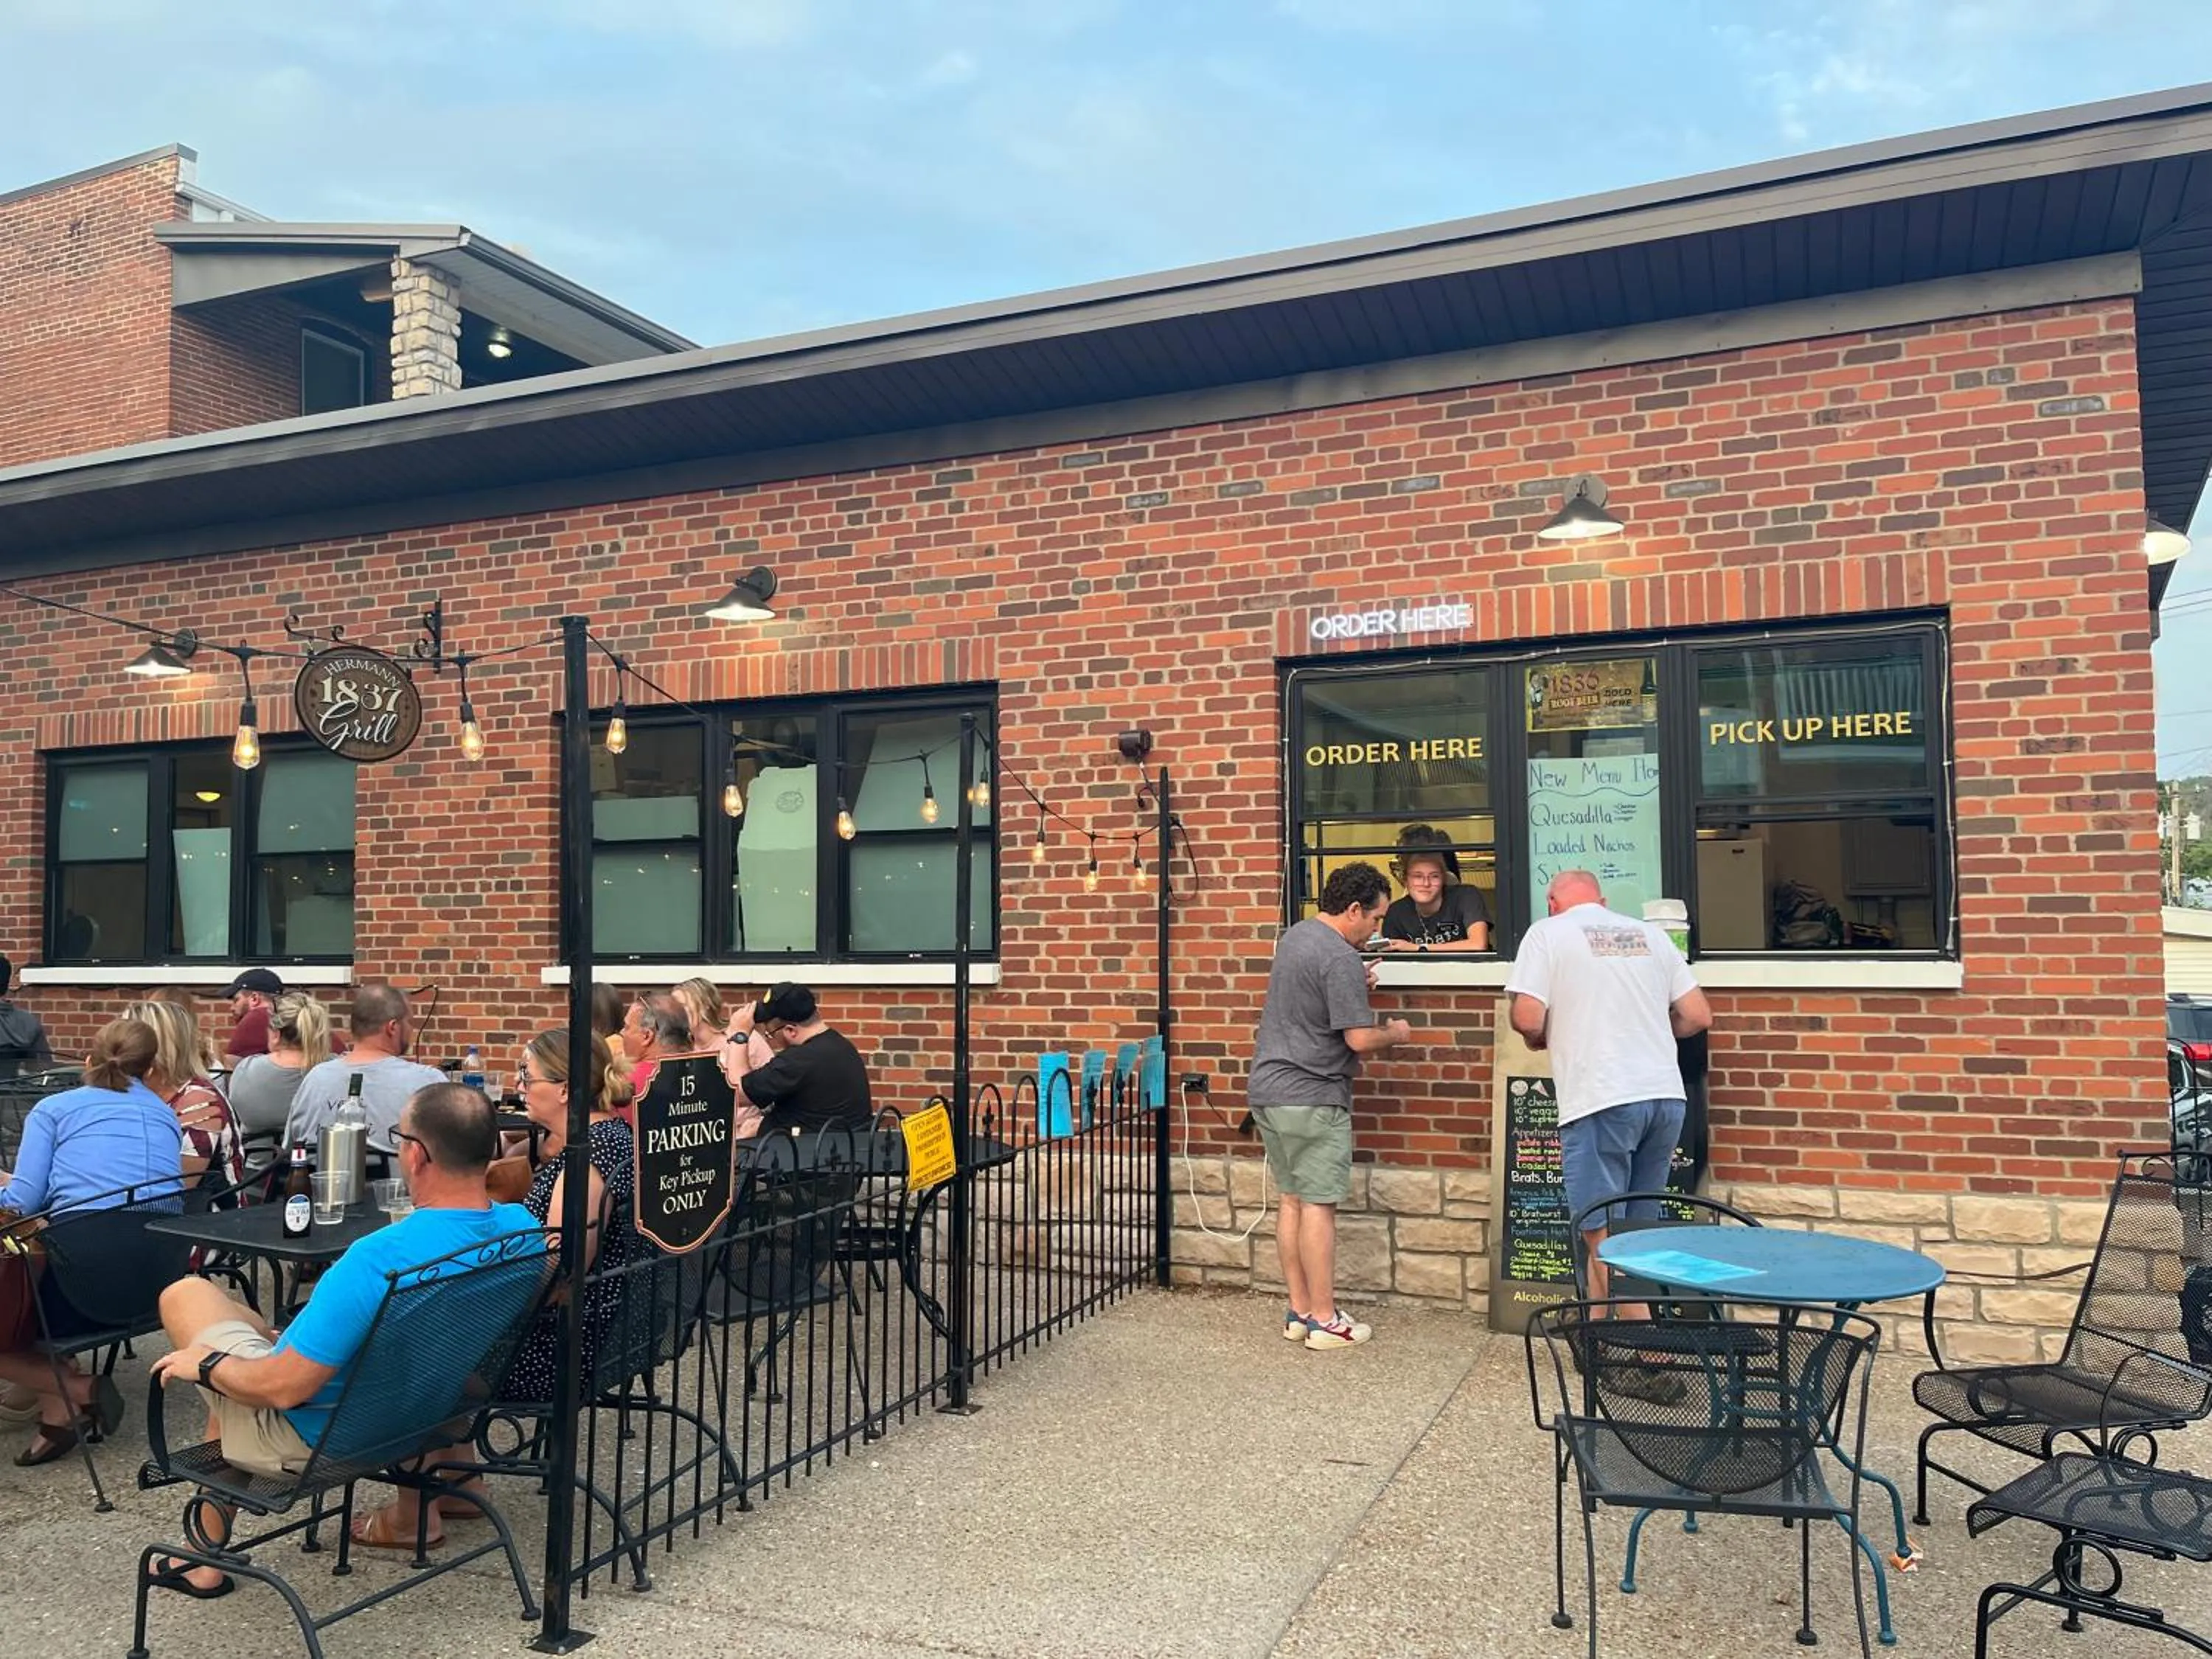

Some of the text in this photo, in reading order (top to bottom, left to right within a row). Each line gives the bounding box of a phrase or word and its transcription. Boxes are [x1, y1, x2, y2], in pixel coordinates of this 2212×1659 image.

[1311, 604, 1471, 639] ORDER HERE
[324, 658, 401, 688] HERMANN
[320, 676, 403, 712] 1837
[317, 700, 399, 751] Grill
[1710, 712, 1913, 745] PICK UP HERE
[1306, 737, 1484, 767] ORDER HERE
[1530, 762, 1568, 788] New
[1582, 761, 1622, 785] Menu
[1530, 803, 1613, 827] Quesadilla
[1534, 831, 1586, 856] Loaded
[679, 1074, 696, 1096] 15
[668, 1099, 709, 1117] Minute
[646, 1118, 726, 1155] PARKING
[679, 1153, 694, 1167] for
[659, 1168, 716, 1192] Key Pickup
[1546, 1170, 1565, 1183] Bur
[663, 1189, 708, 1215] ONLY
